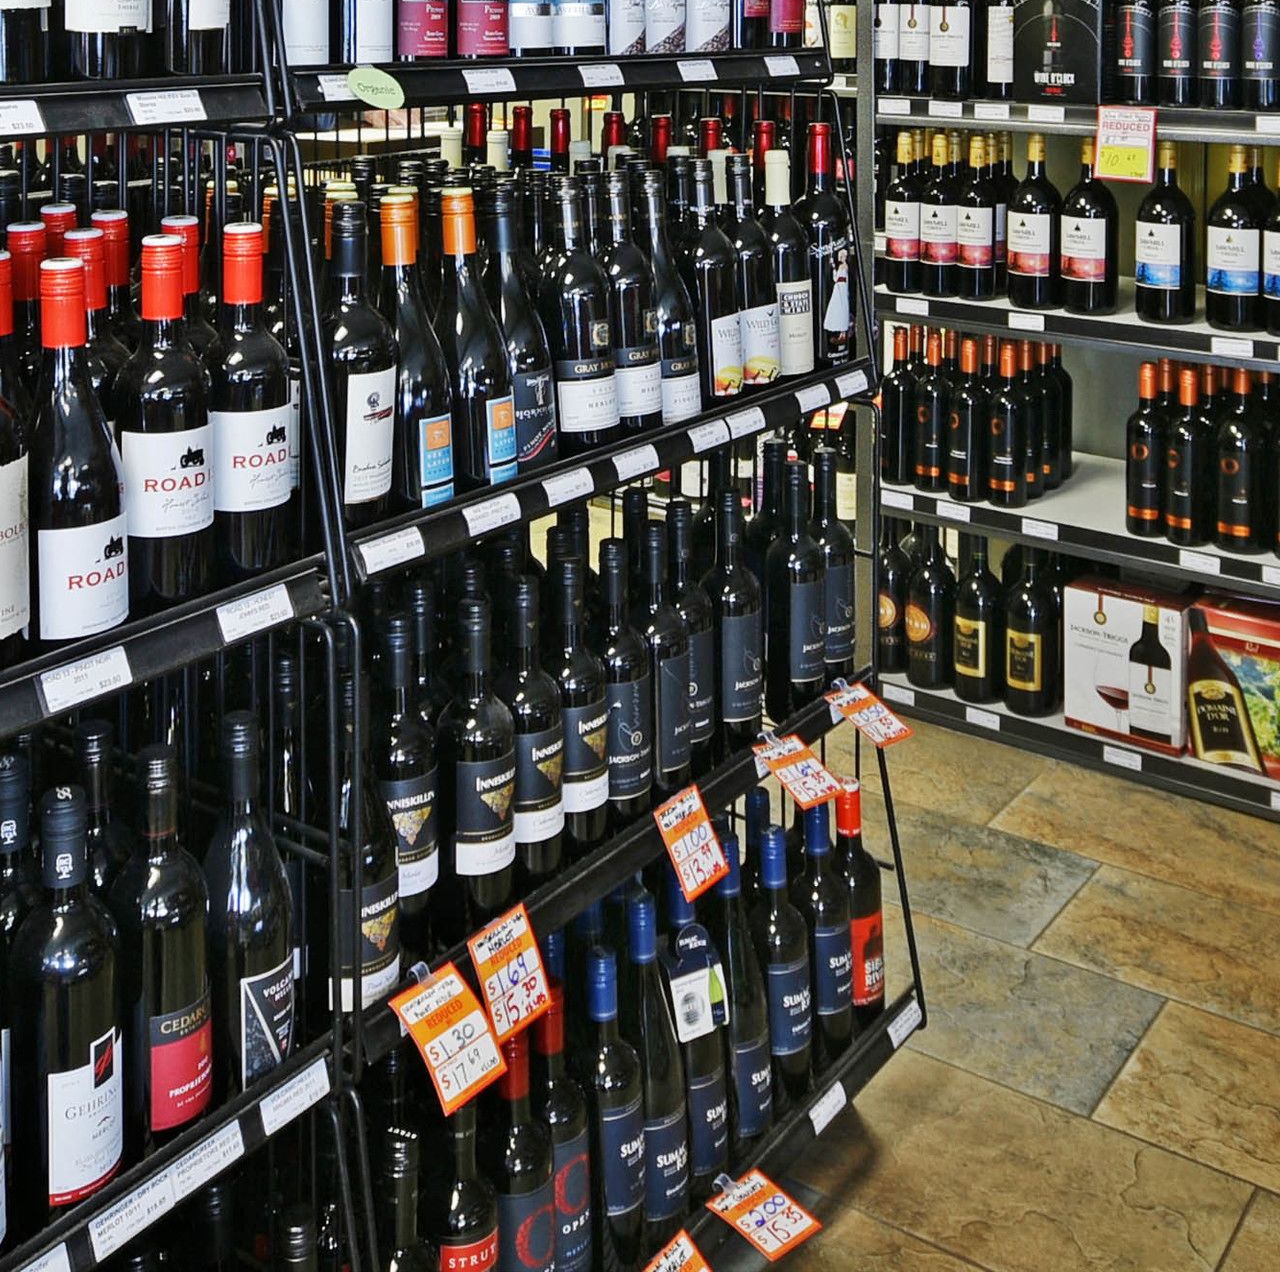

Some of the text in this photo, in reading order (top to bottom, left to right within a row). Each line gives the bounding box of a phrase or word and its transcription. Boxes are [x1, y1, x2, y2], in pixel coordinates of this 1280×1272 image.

[357, 81, 397, 96] Organic
[1102, 121, 1151, 133] REDUCED
[574, 364, 598, 374] GRAY
[232, 452, 286, 469] ROAD
[144, 473, 204, 493] ROAD
[68, 561, 124, 591] ROAD
[489, 940, 522, 966] REDUCED
[425, 1000, 463, 1029] REDUCED
